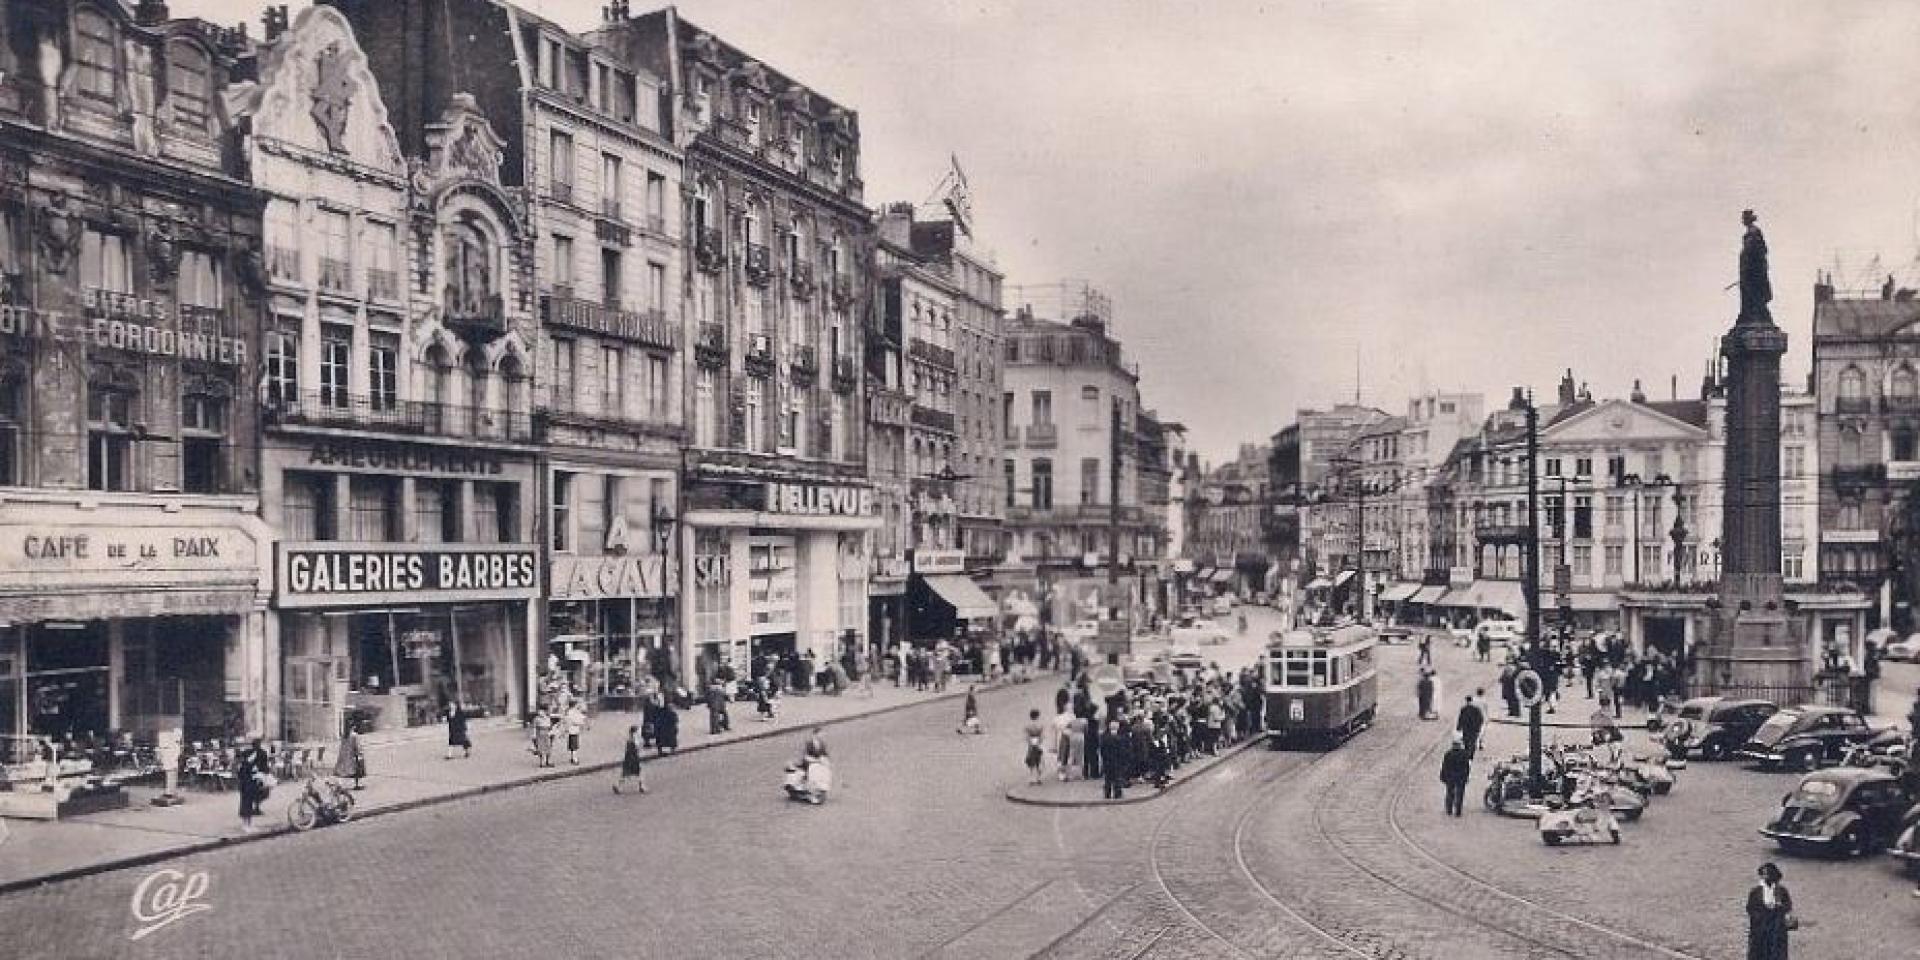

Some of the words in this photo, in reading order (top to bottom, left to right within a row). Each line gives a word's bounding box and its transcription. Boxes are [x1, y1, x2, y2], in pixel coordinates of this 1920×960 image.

[107, 543, 127, 558] DE
[140, 543, 158, 558] LA
[172, 537, 219, 558] PAIX
[290, 553, 424, 592] GALERIES
[437, 553, 534, 588] BARBES
